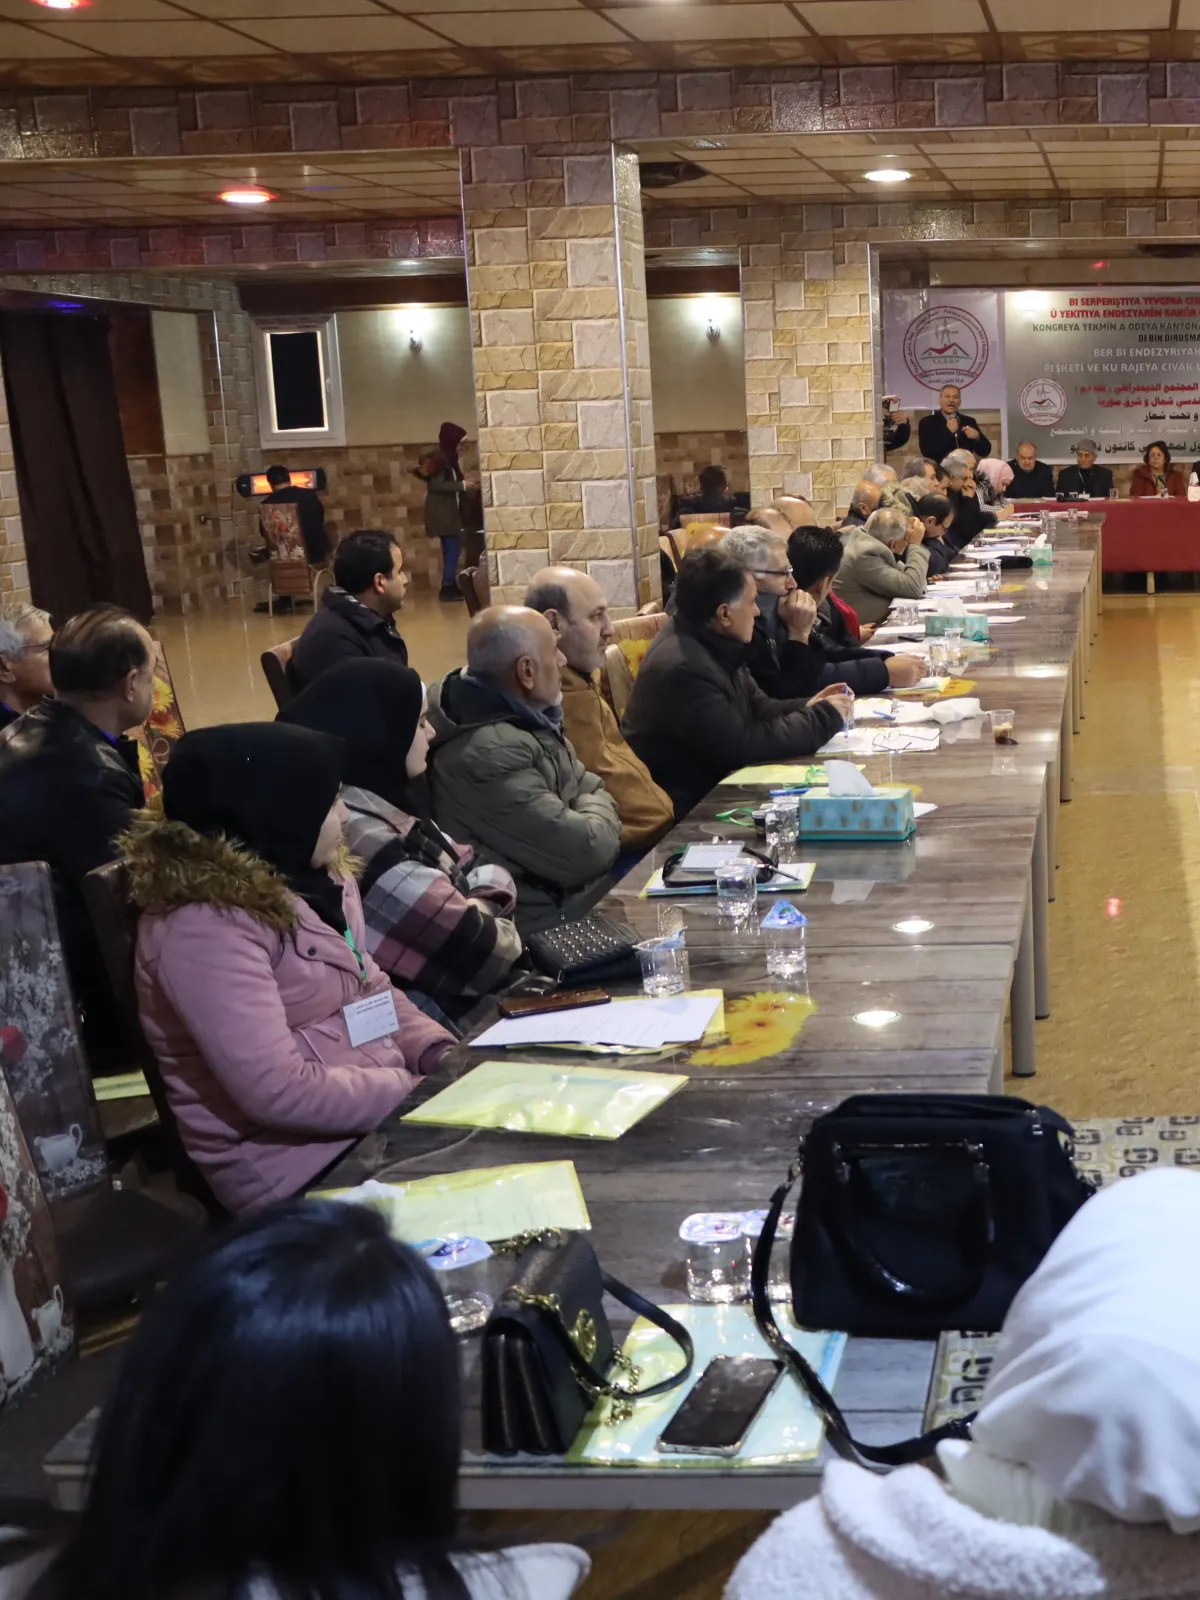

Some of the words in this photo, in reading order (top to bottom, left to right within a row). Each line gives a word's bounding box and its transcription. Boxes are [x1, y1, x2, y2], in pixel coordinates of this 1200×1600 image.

[1069, 297, 1078, 306] BI
[1050, 308, 1057, 318] Û
[1032, 324, 1080, 332] KONGREYA
[1119, 322, 1126, 332] A
[1128, 322, 1158, 332] ODEYA
[1138, 334, 1147, 342] DI
[1093, 348, 1113, 358] BER
[1116, 348, 1126, 357] BI
[1087, 363, 1100, 372] VE
[1102, 363, 1118, 372] KU
[1164, 382, 1198, 394] المجتمع
[1122, 397, 1142, 408] شرق
[1144, 398, 1150, 408] و
[1151, 396, 1174, 408] شمال
[1144, 410, 1166, 422] شعار
[1168, 411, 1191, 420] تحت
[1193, 412, 1199, 422] و
[1104, 440, 1136, 454] كانتون
